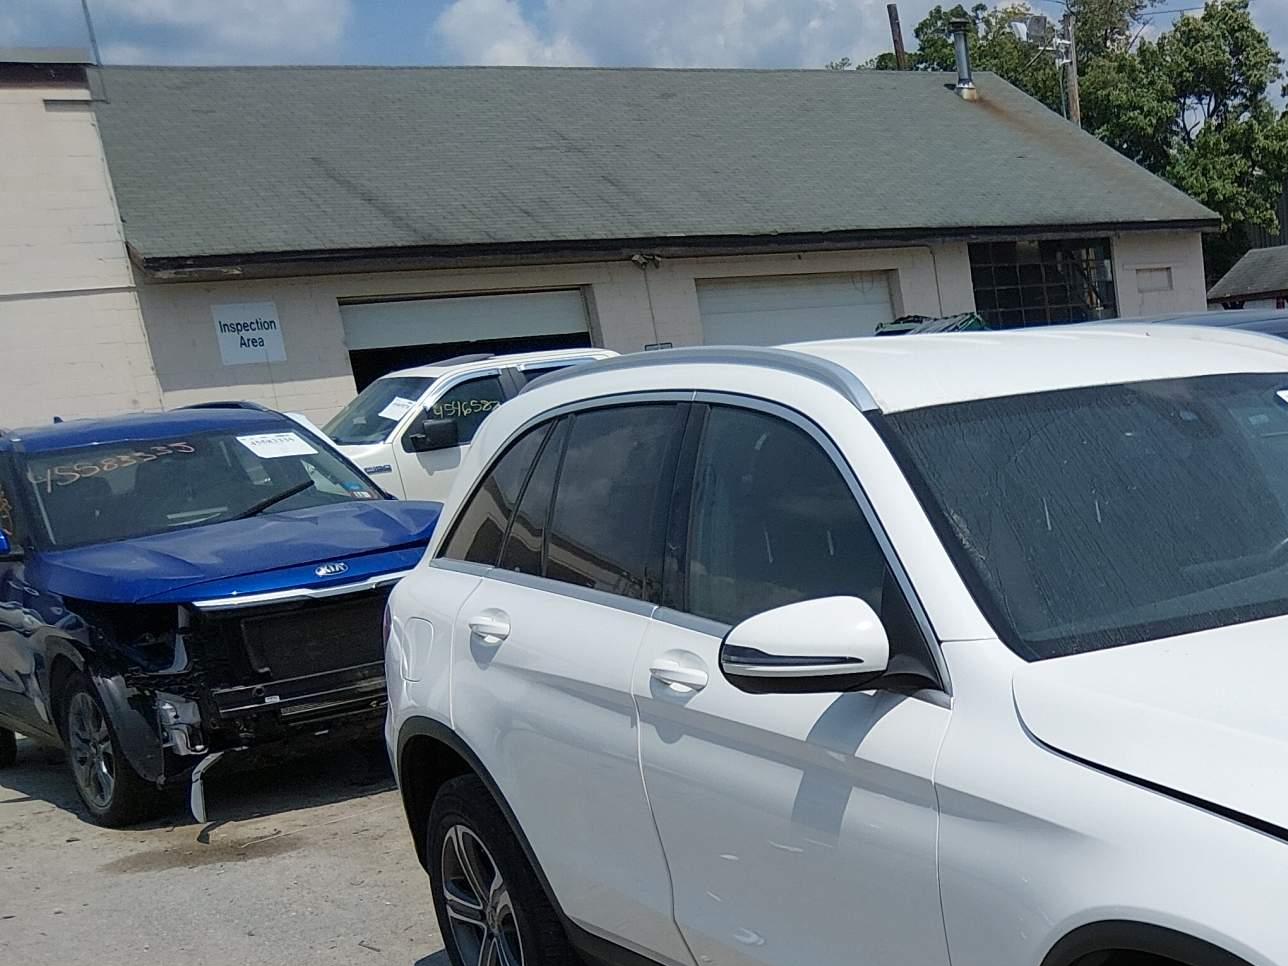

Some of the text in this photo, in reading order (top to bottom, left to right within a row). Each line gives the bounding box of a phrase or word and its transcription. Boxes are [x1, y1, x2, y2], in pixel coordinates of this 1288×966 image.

[218, 318, 277, 335] Inspection
[240, 336, 265, 348] Area
[318, 562, 346, 576] KIA
